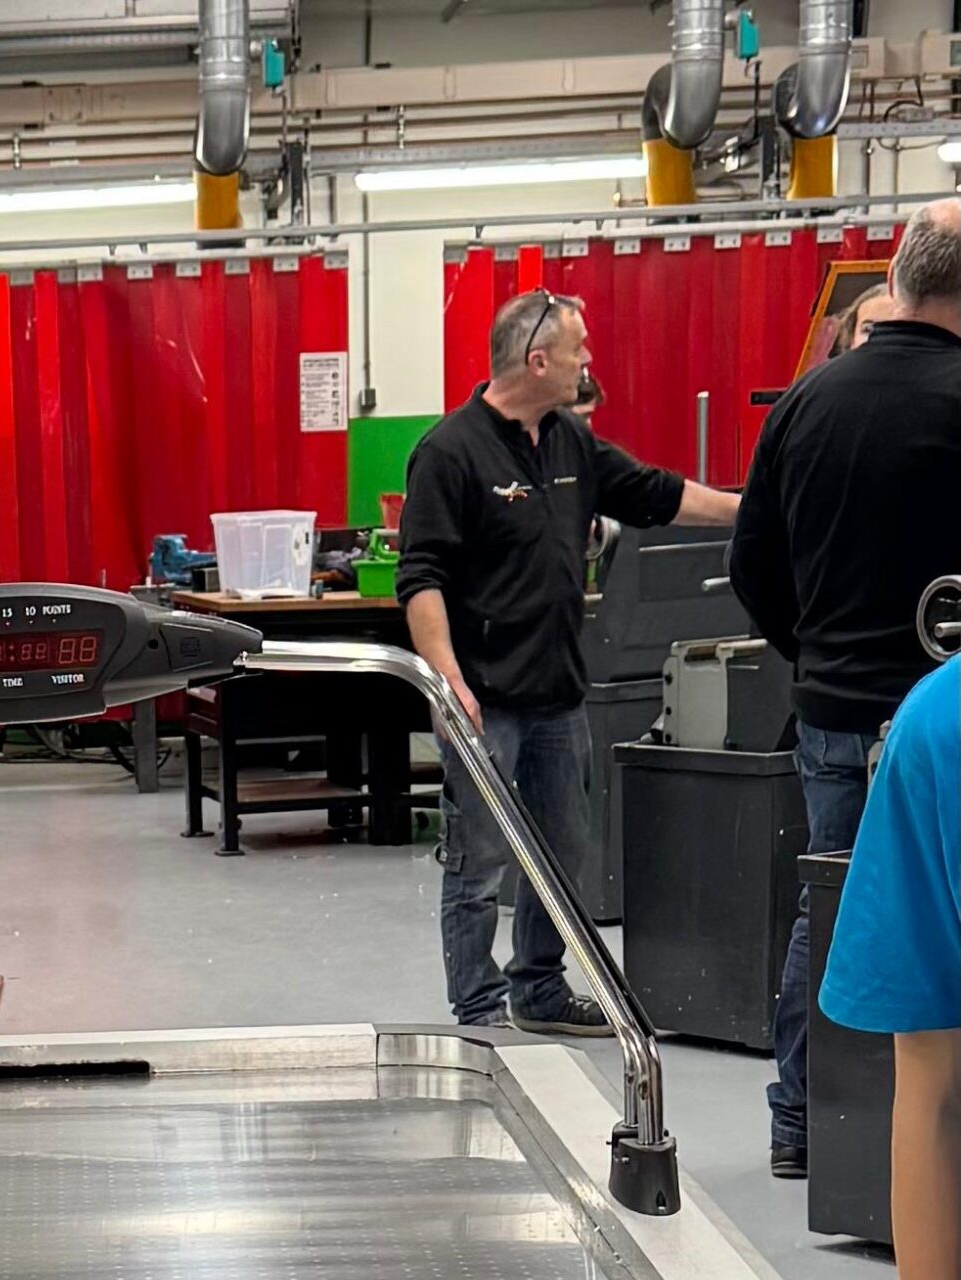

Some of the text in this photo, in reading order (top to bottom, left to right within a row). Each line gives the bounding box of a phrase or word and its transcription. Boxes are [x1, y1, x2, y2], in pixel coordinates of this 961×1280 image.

[2, 607, 13, 618] 15
[25, 605, 37, 616] 10
[3, 677, 23, 687] TIME
[51, 674, 84, 685] VISITOR
